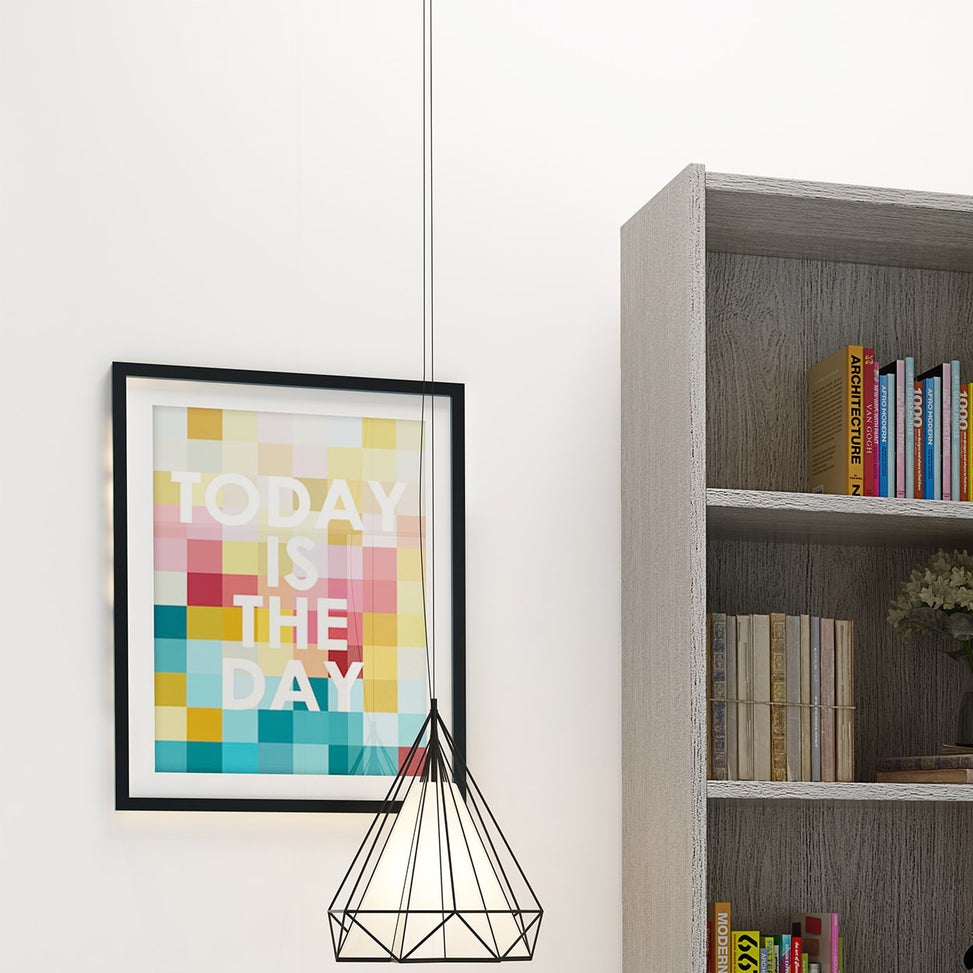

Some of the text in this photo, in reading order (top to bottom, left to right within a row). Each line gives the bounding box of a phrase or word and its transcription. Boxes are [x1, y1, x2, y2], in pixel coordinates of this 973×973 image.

[851, 355, 861, 464] ARCHITECTURE
[914, 388, 923, 427] 1000
[960, 390, 968, 430] 1000
[170, 471, 408, 533] TODAY
[266, 535, 318, 591] IS
[233, 595, 348, 651] THE
[222, 658, 364, 713] DAY
